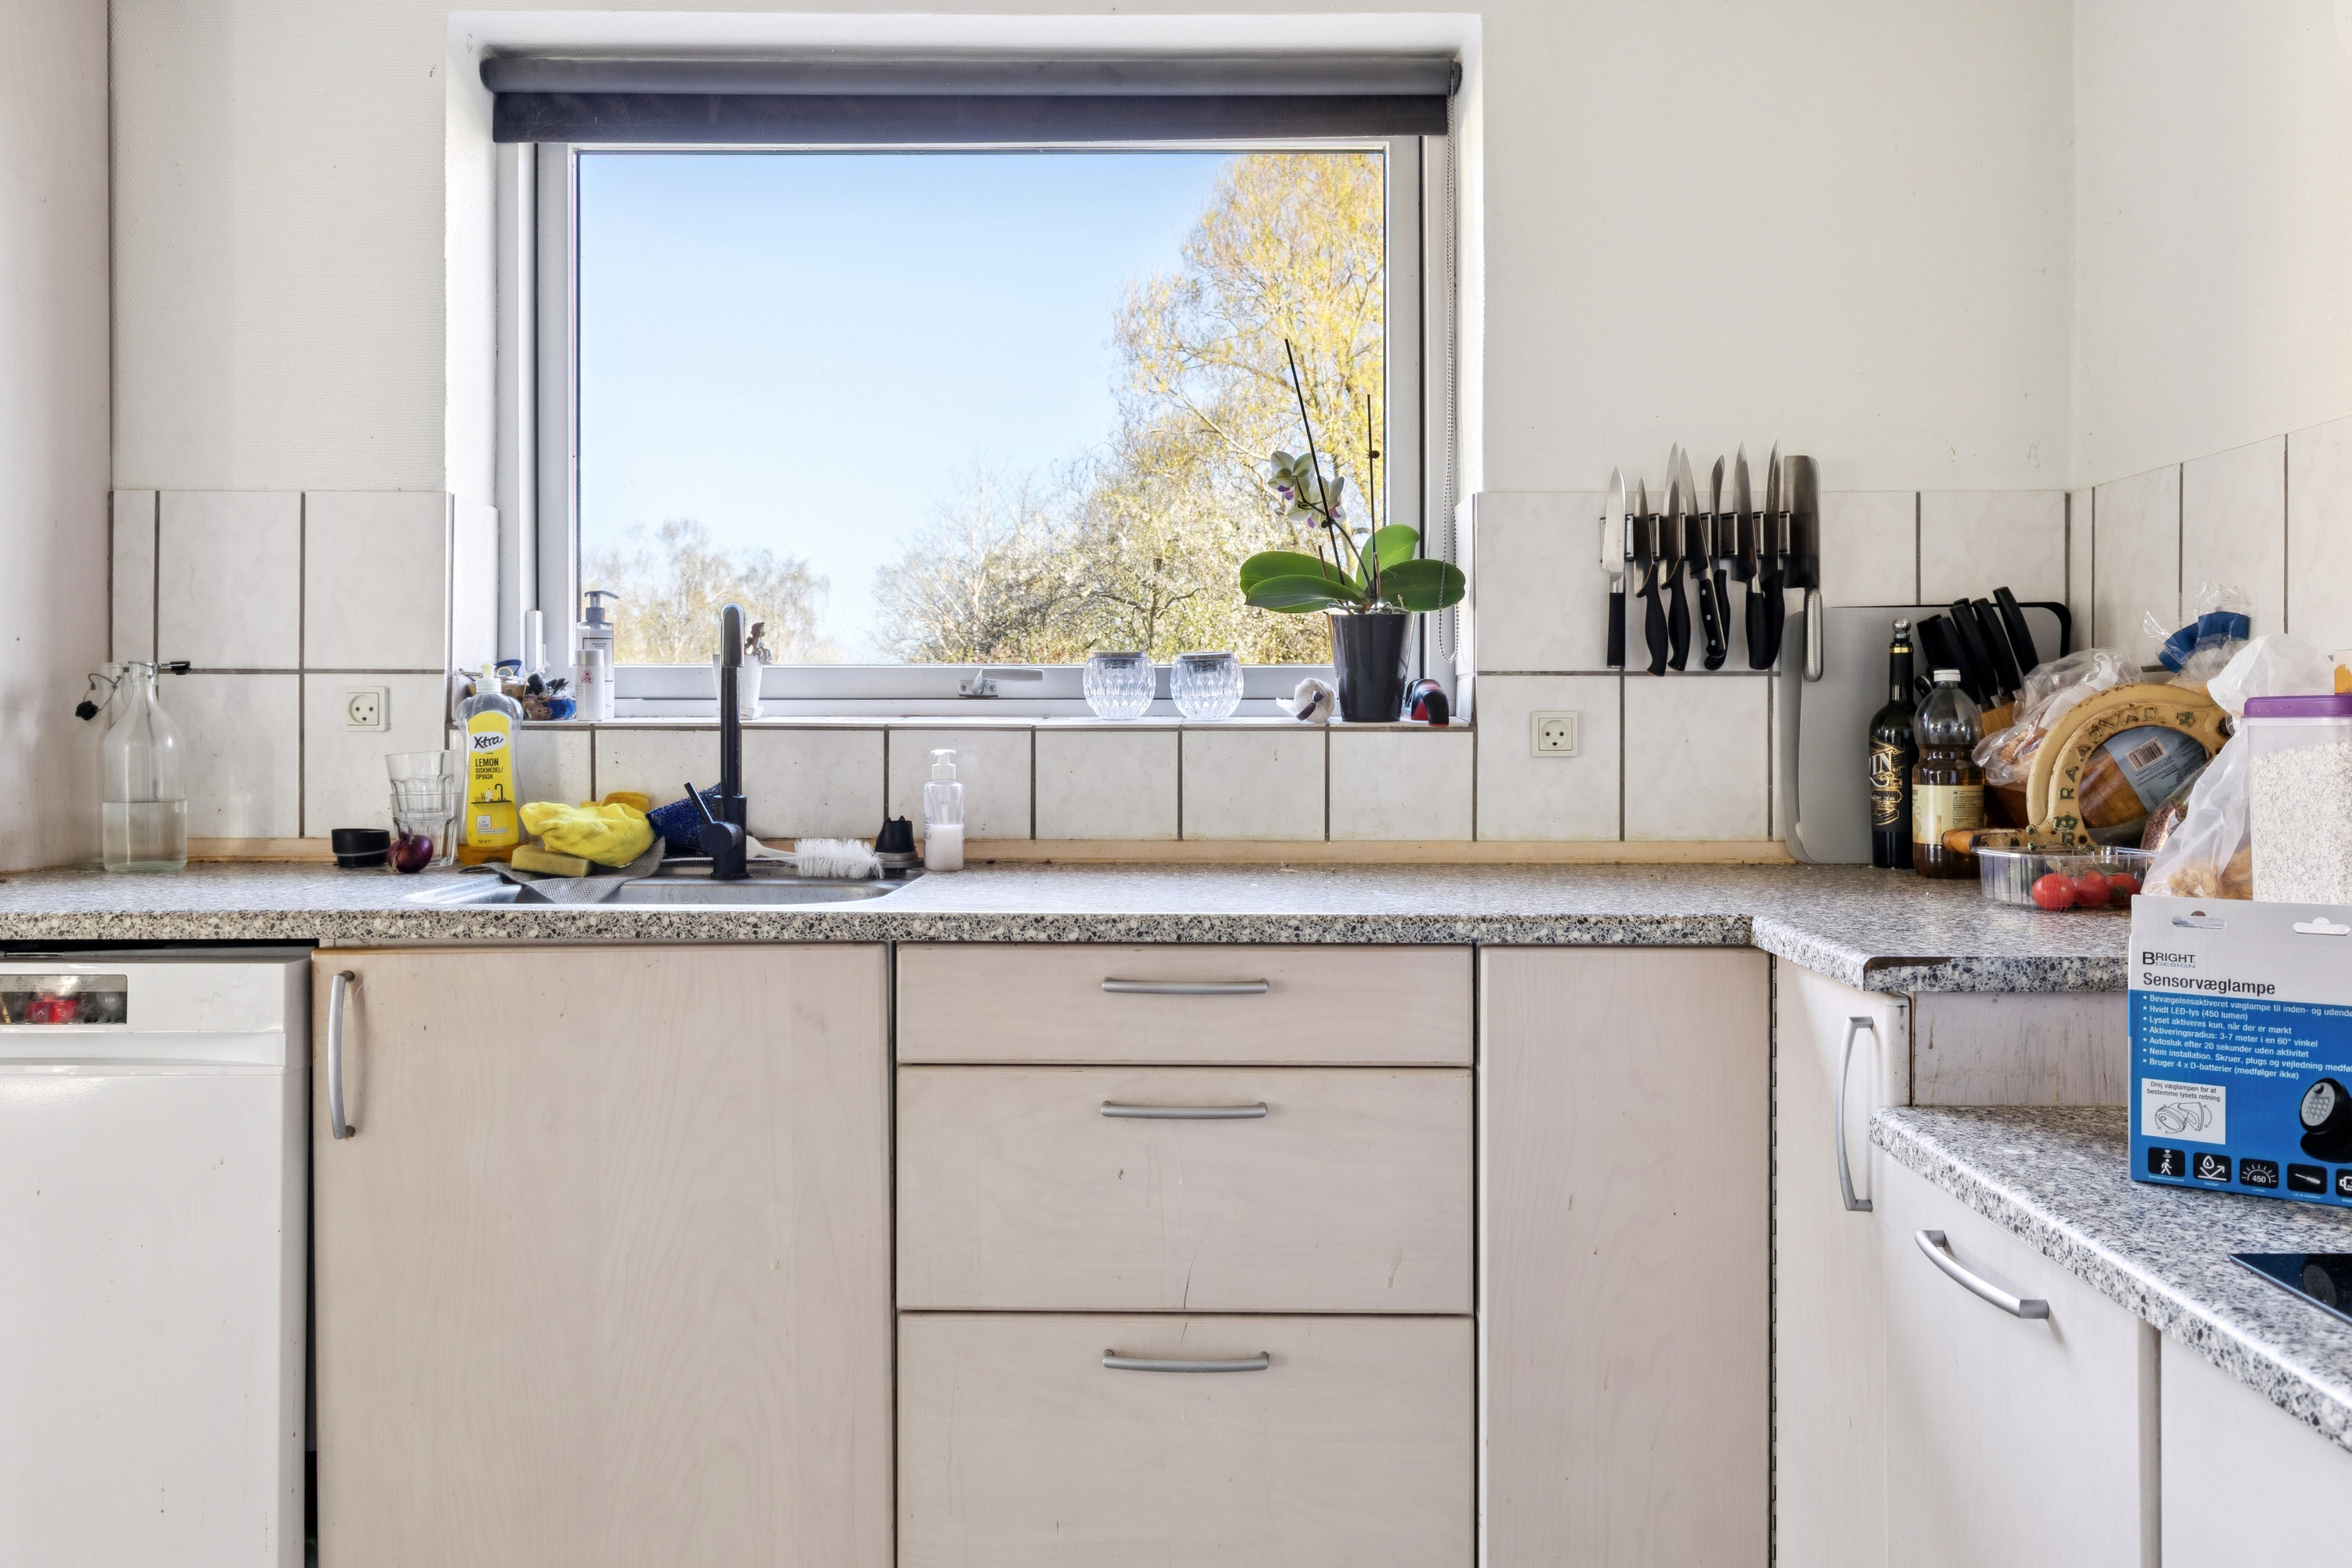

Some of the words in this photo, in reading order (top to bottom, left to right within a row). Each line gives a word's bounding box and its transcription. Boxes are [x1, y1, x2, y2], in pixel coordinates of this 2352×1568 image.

[475, 758, 499, 767] LEMON
[2143, 972, 2275, 996] Sensorvæglampe
[2150, 994, 2228, 1008] Bevægelsesaktiveret
[2230, 1002, 2271, 1011] væglampe
[2311, 1007, 2321, 1016] og
[2150, 1005, 2169, 1014] Hvidt
[2171, 1007, 2200, 1017] LED-lys
[2201, 1010, 2219, 1018] (450
[2221, 1011, 2248, 1021] lumen)
[2150, 1016, 2169, 1025] Lyset
[2172, 1018, 2206, 1027] aktiveres
[2209, 1021, 2225, 1030] kun,
[2150, 1026, 2217, 1040] Aktiveringsradius:
[2294, 1039, 2318, 1047] vinkel
[2150, 1037, 2182, 1047] Autosluk
[2216, 1044, 2252, 1053] sekunder
[2277, 1049, 2309, 1058] aktivitet
[2150, 1058, 2174, 1068] Bruger
[2190, 1062, 2232, 1073] D-batterier
[2234, 1067, 2277, 1078] (medfølger
[2279, 1070, 2299, 1080] ikke)
[2169, 1049, 2212, 1060] installation.
[2216, 1054, 2243, 1064] Skruer,
[2245, 1057, 2267, 1065] plugs
[2281, 1060, 2322, 1071] vejledning
[2147, 1088, 2178, 1097] bestemme
[2165, 1083, 2198, 1091] væglampen
